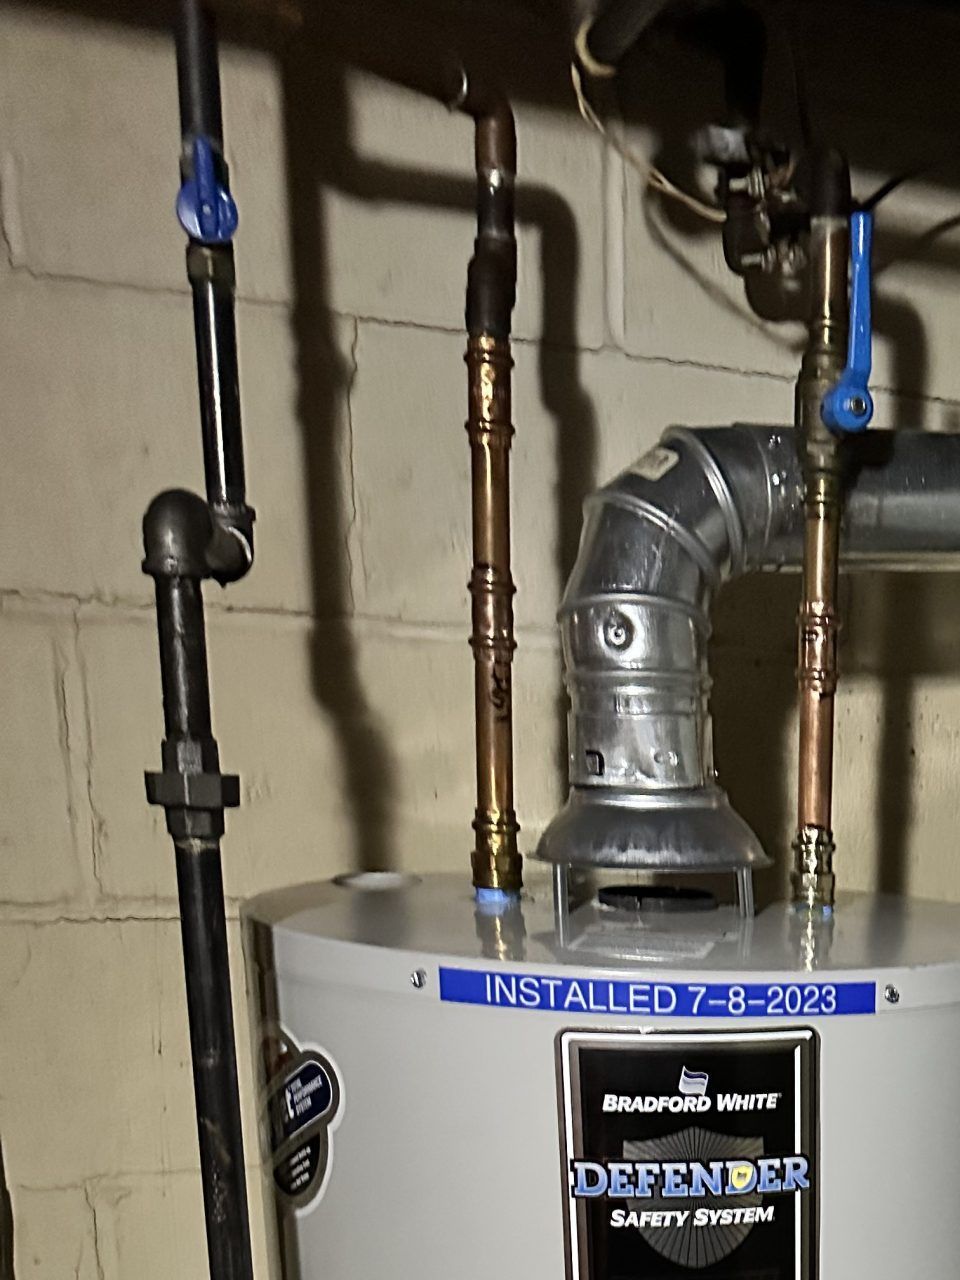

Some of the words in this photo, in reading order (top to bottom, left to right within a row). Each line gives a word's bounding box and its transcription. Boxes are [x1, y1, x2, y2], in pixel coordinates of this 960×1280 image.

[486, 974, 677, 1014] INSTALLED
[688, 984, 837, 1014] 7-8-2023
[602, 1093, 711, 1113] BRADFORD
[716, 1093, 779, 1112] WHITE
[573, 1156, 810, 1198] DEFENDER
[610, 1209, 690, 1228] SAFETY
[693, 1206, 775, 1227] SYSTEM
